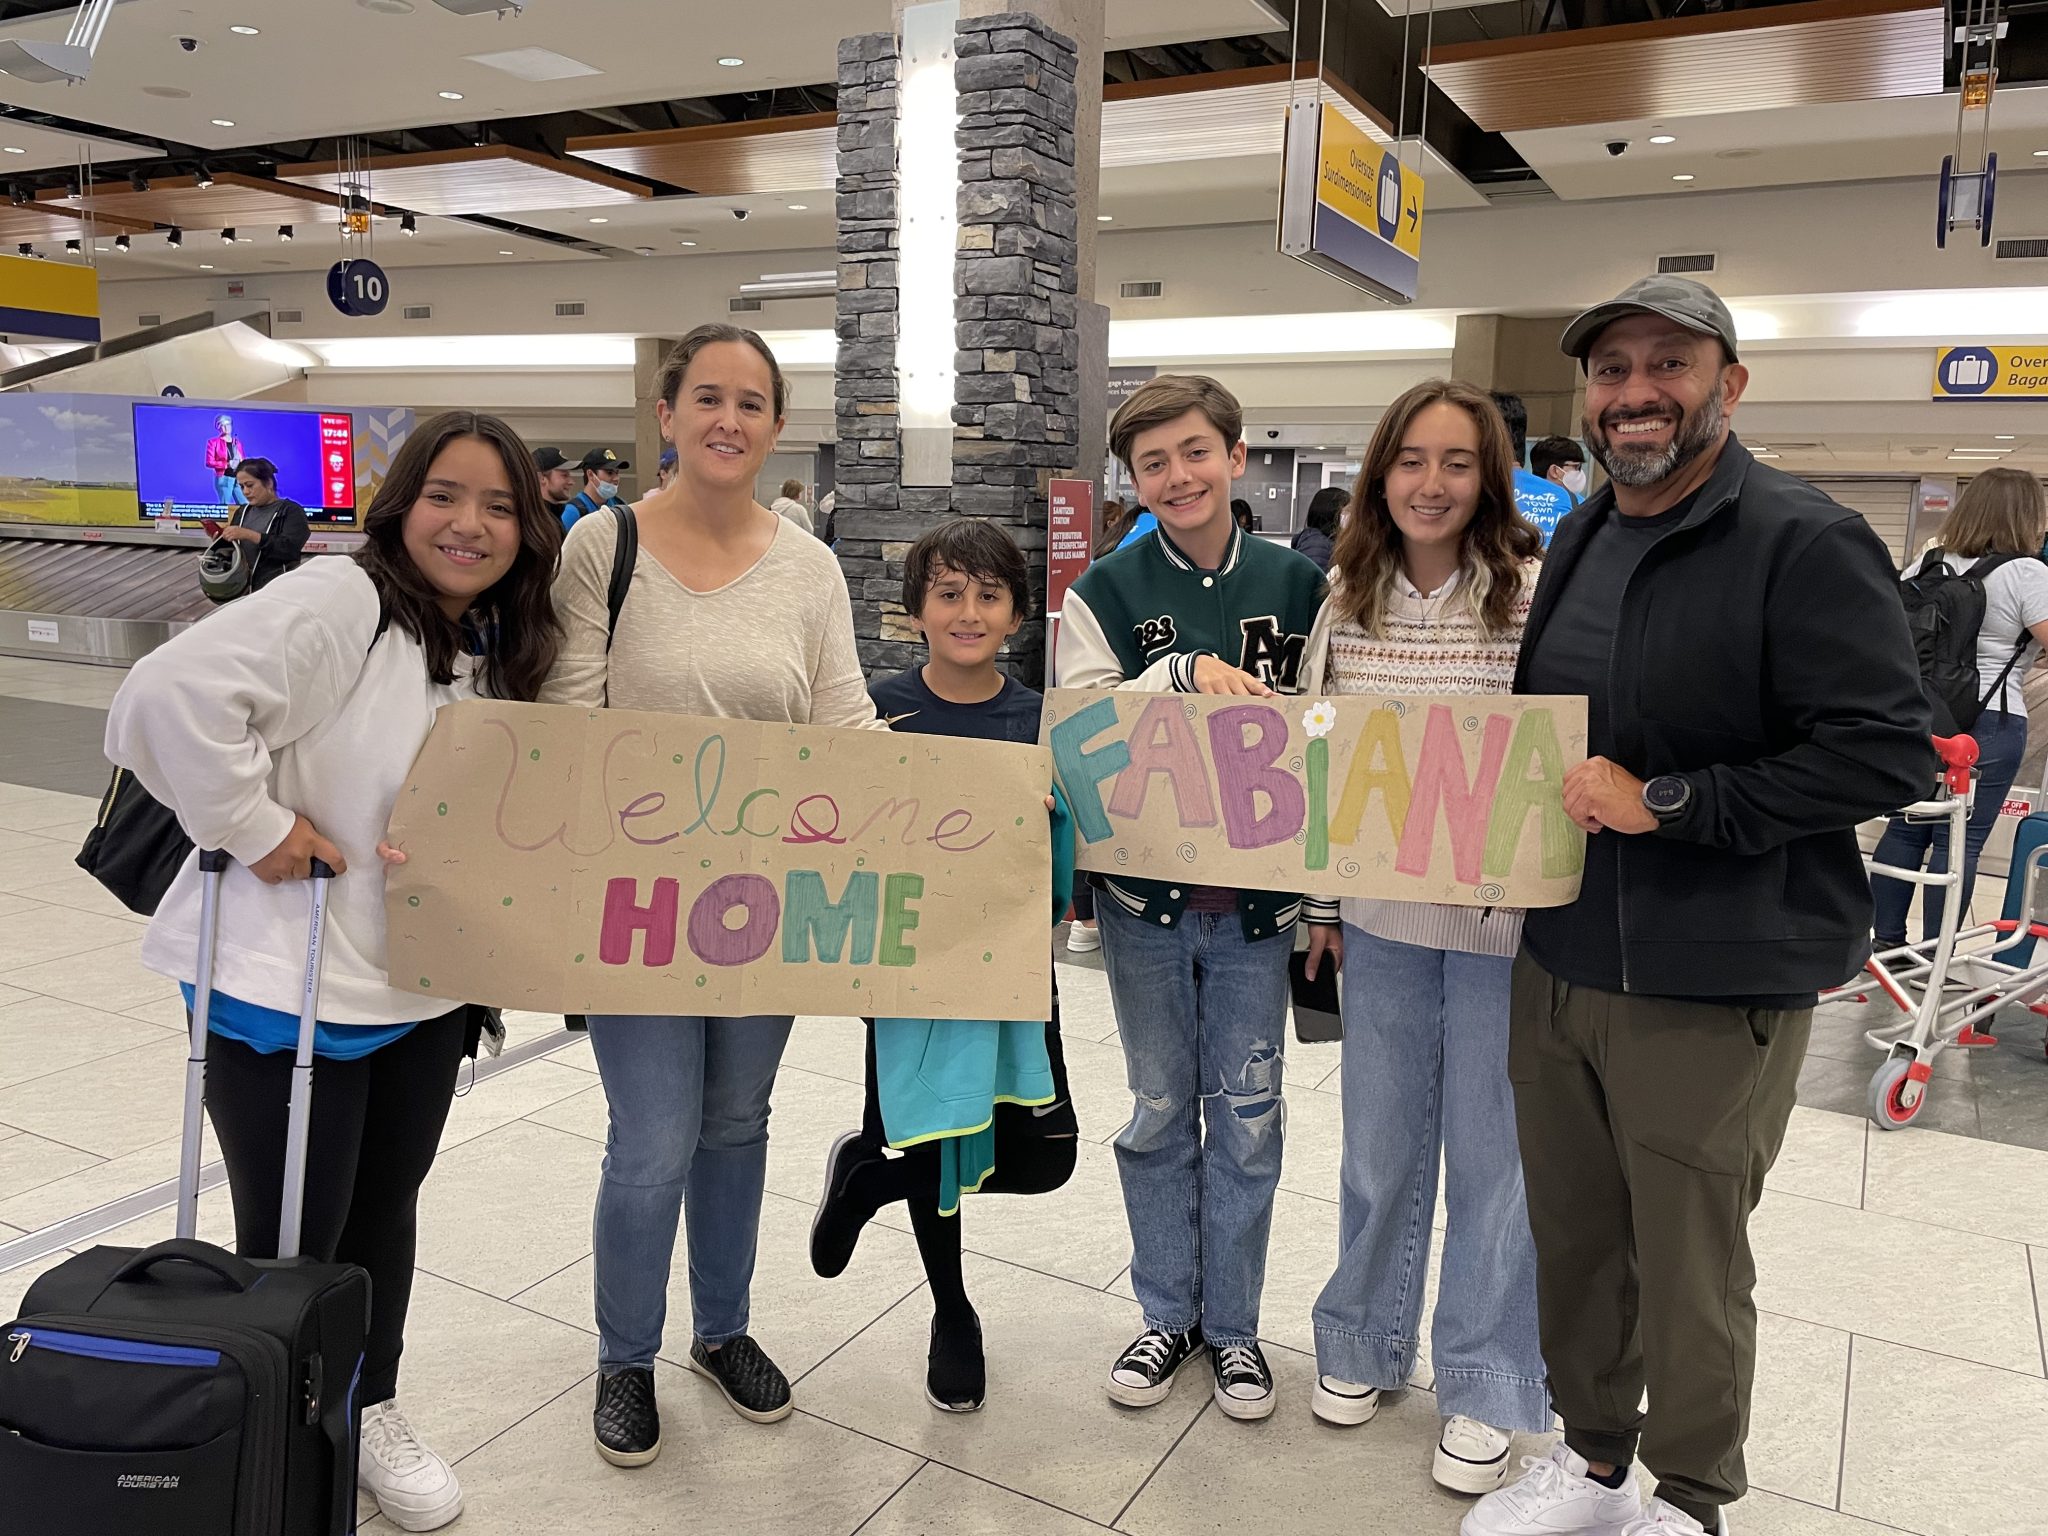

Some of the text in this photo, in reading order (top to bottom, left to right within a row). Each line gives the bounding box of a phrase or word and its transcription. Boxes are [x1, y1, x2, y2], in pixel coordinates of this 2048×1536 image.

[1350, 149, 1374, 181] Oversize
[1324, 161, 1372, 207] Surdimensionnés
[353, 275, 382, 301] 10
[2010, 356, 2048, 368] Over
[2008, 373, 2048, 388] Baga
[1514, 488, 1559, 503] Create
[483, 718, 996, 857] Welcome
[600, 870, 925, 967] HOME
[307, 903, 321, 994] AMERICAN TOURISTER
[117, 1474, 180, 1482] AMERICAN
[117, 1480, 179, 1489] TOURISTER
